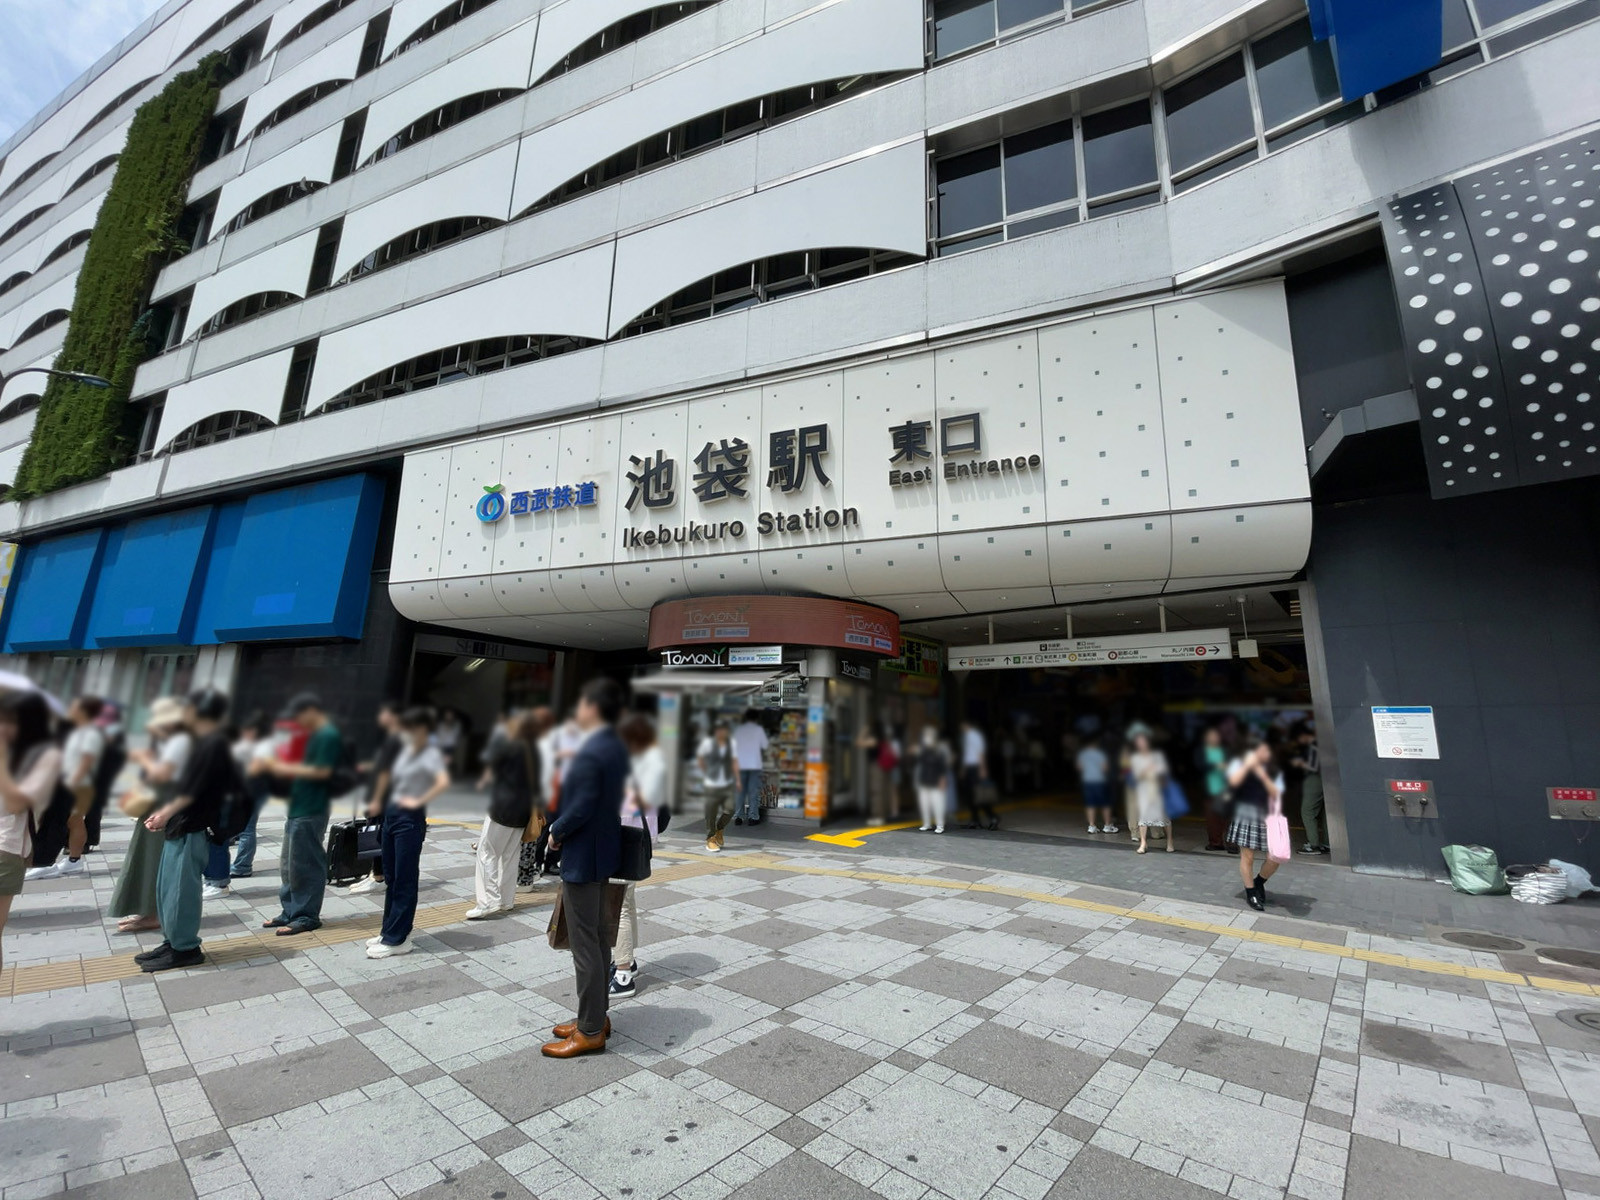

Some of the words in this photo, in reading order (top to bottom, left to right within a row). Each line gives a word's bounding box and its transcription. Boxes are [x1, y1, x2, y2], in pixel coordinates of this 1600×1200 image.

[888, 412, 981, 465] 東口
[624, 423, 833, 512] 池袋駅
[888, 466, 932, 488] East
[944, 453, 1041, 481] Entrance
[509, 481, 598, 516] 西武鉄道
[623, 517, 745, 549] Ikebukuro
[757, 504, 859, 536] Station
